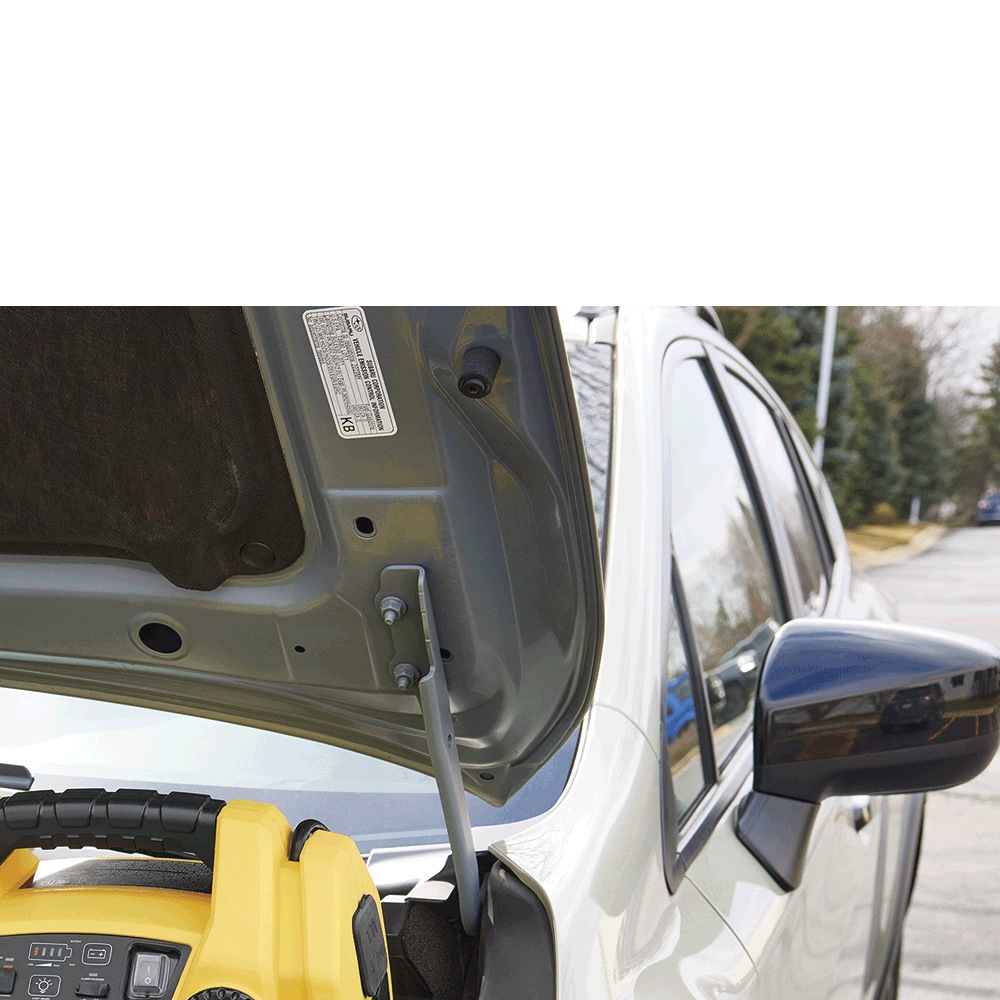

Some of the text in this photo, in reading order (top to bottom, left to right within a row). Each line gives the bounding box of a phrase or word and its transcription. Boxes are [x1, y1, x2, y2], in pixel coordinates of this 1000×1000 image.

[352, 338, 384, 431] VEHICLE EMISSION CONTROL INFORMATION
[365, 359, 385, 410] SUBARU CORPORATION
[340, 416, 356, 433] KB
